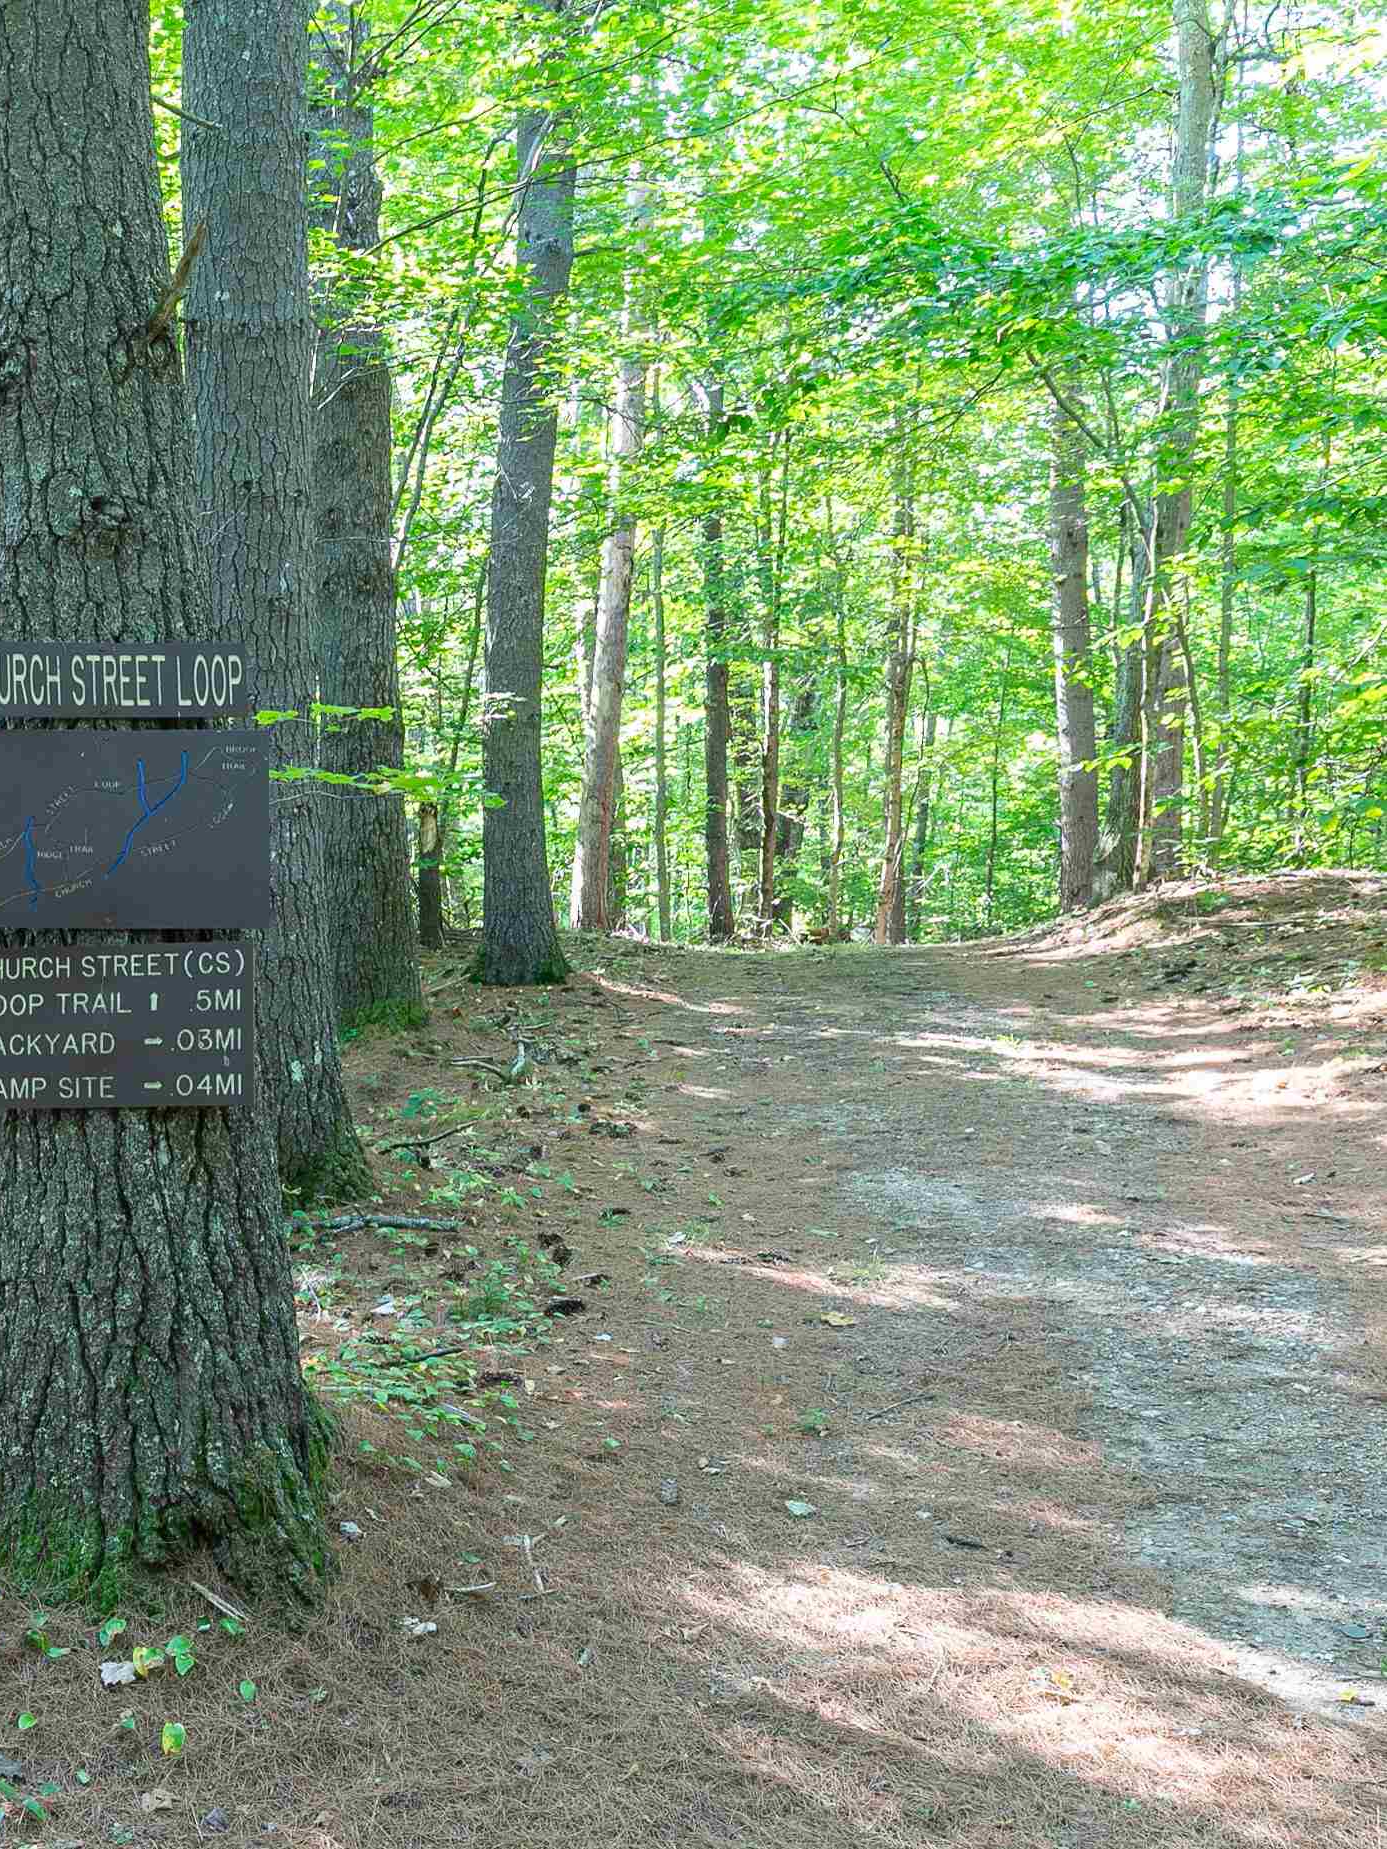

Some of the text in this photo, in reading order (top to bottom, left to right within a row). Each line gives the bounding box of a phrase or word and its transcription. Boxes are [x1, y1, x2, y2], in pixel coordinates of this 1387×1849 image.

[71, 654, 165, 707] STREET
[176, 654, 243, 707] LOOP
[56, 991, 132, 1015] TRAIL
[59, 1076, 115, 1099] SITE
